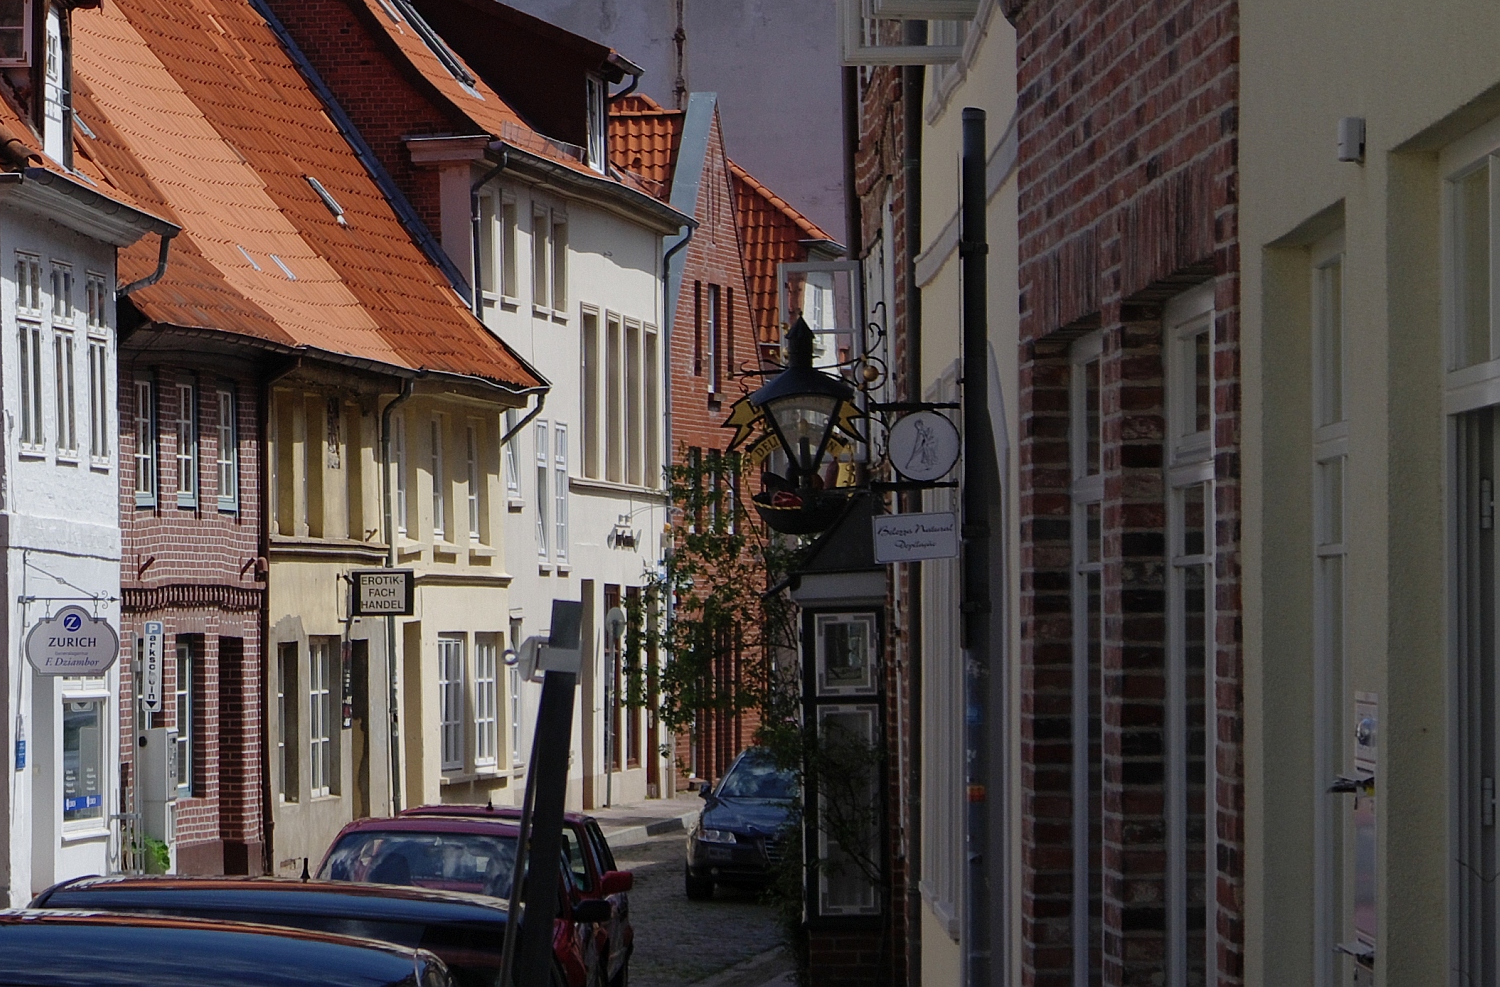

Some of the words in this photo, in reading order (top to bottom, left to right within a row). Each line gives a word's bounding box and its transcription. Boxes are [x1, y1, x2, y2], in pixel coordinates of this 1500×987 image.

[361, 576, 404, 585] EROTIK-
[368, 588, 396, 597] FACH
[360, 600, 404, 609] HANDEL
[64, 616, 80, 631] Z
[48, 637, 98, 648] ZURICH
[45, 657, 54, 667] F.
[55, 655, 100, 667] Dziambor
[148, 623, 159, 700] Parkscin
